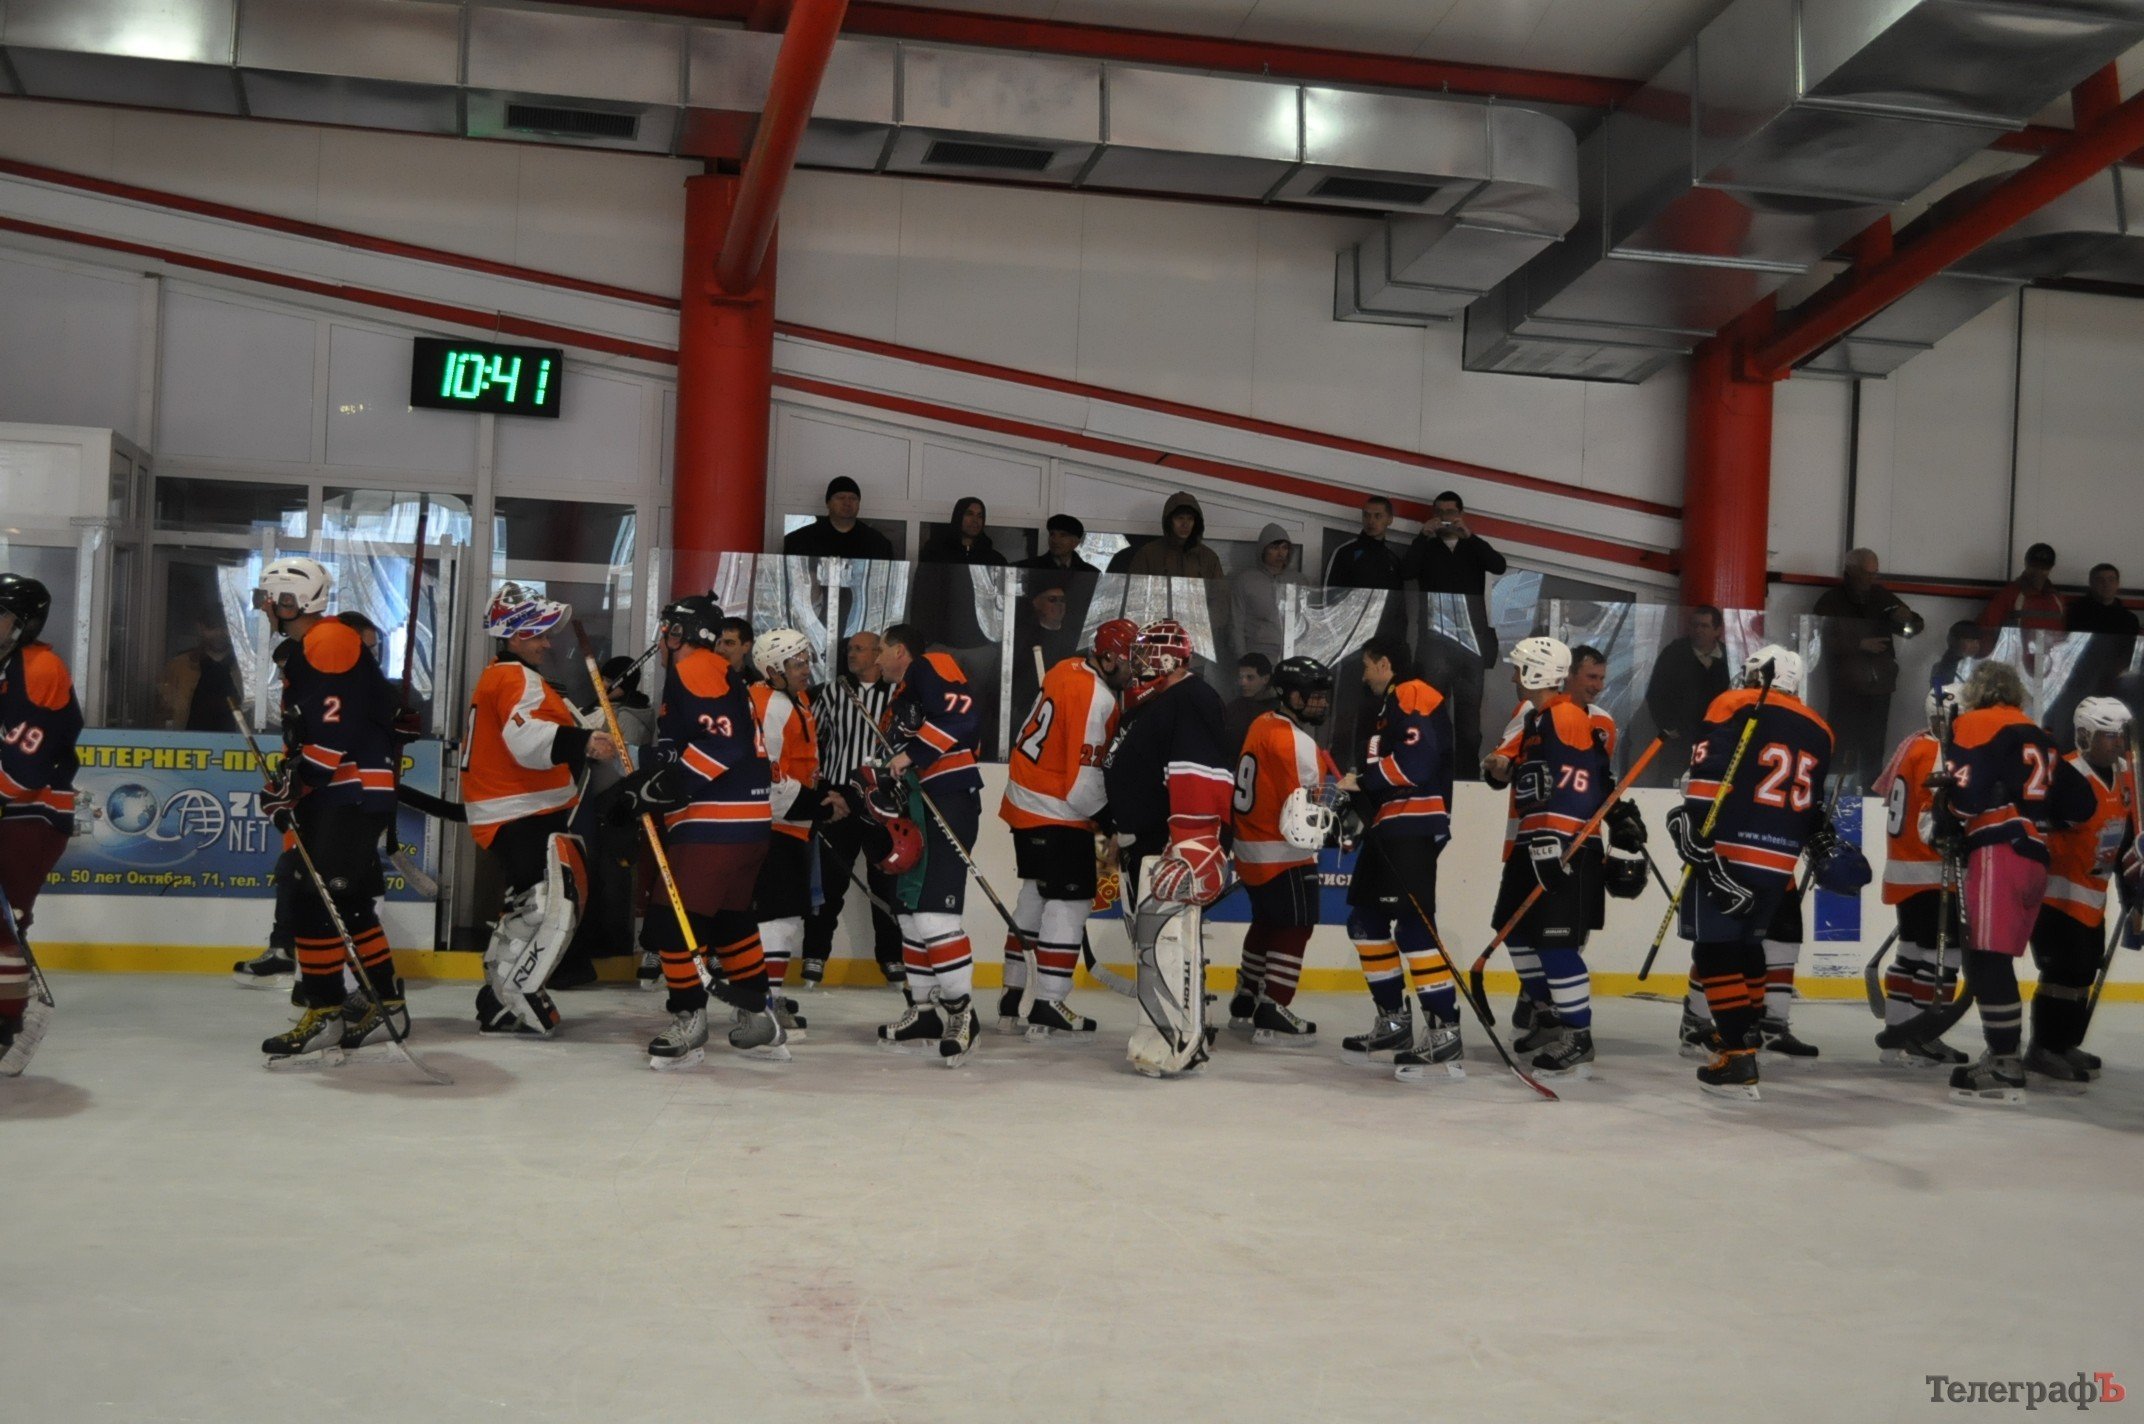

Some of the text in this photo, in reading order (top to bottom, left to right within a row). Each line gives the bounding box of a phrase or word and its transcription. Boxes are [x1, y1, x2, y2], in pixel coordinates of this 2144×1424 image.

[442, 351, 551, 405] 10:41
[322, 695, 342, 723] 2
[944, 692, 973, 715] 77
[698, 713, 734, 738] 23
[1402, 726, 1421, 746] 3
[1557, 763, 1591, 793] 76
[1753, 741, 1819, 813] 25
[228, 819, 270, 853] NET
[70, 869, 90, 883] 50
[94, 873, 122, 884] лет
[202, 873, 225, 887] 71,
[230, 876, 261, 887] тел.
[386, 877, 405, 891] 70
[1181, 960, 1191, 1010] ITECH
